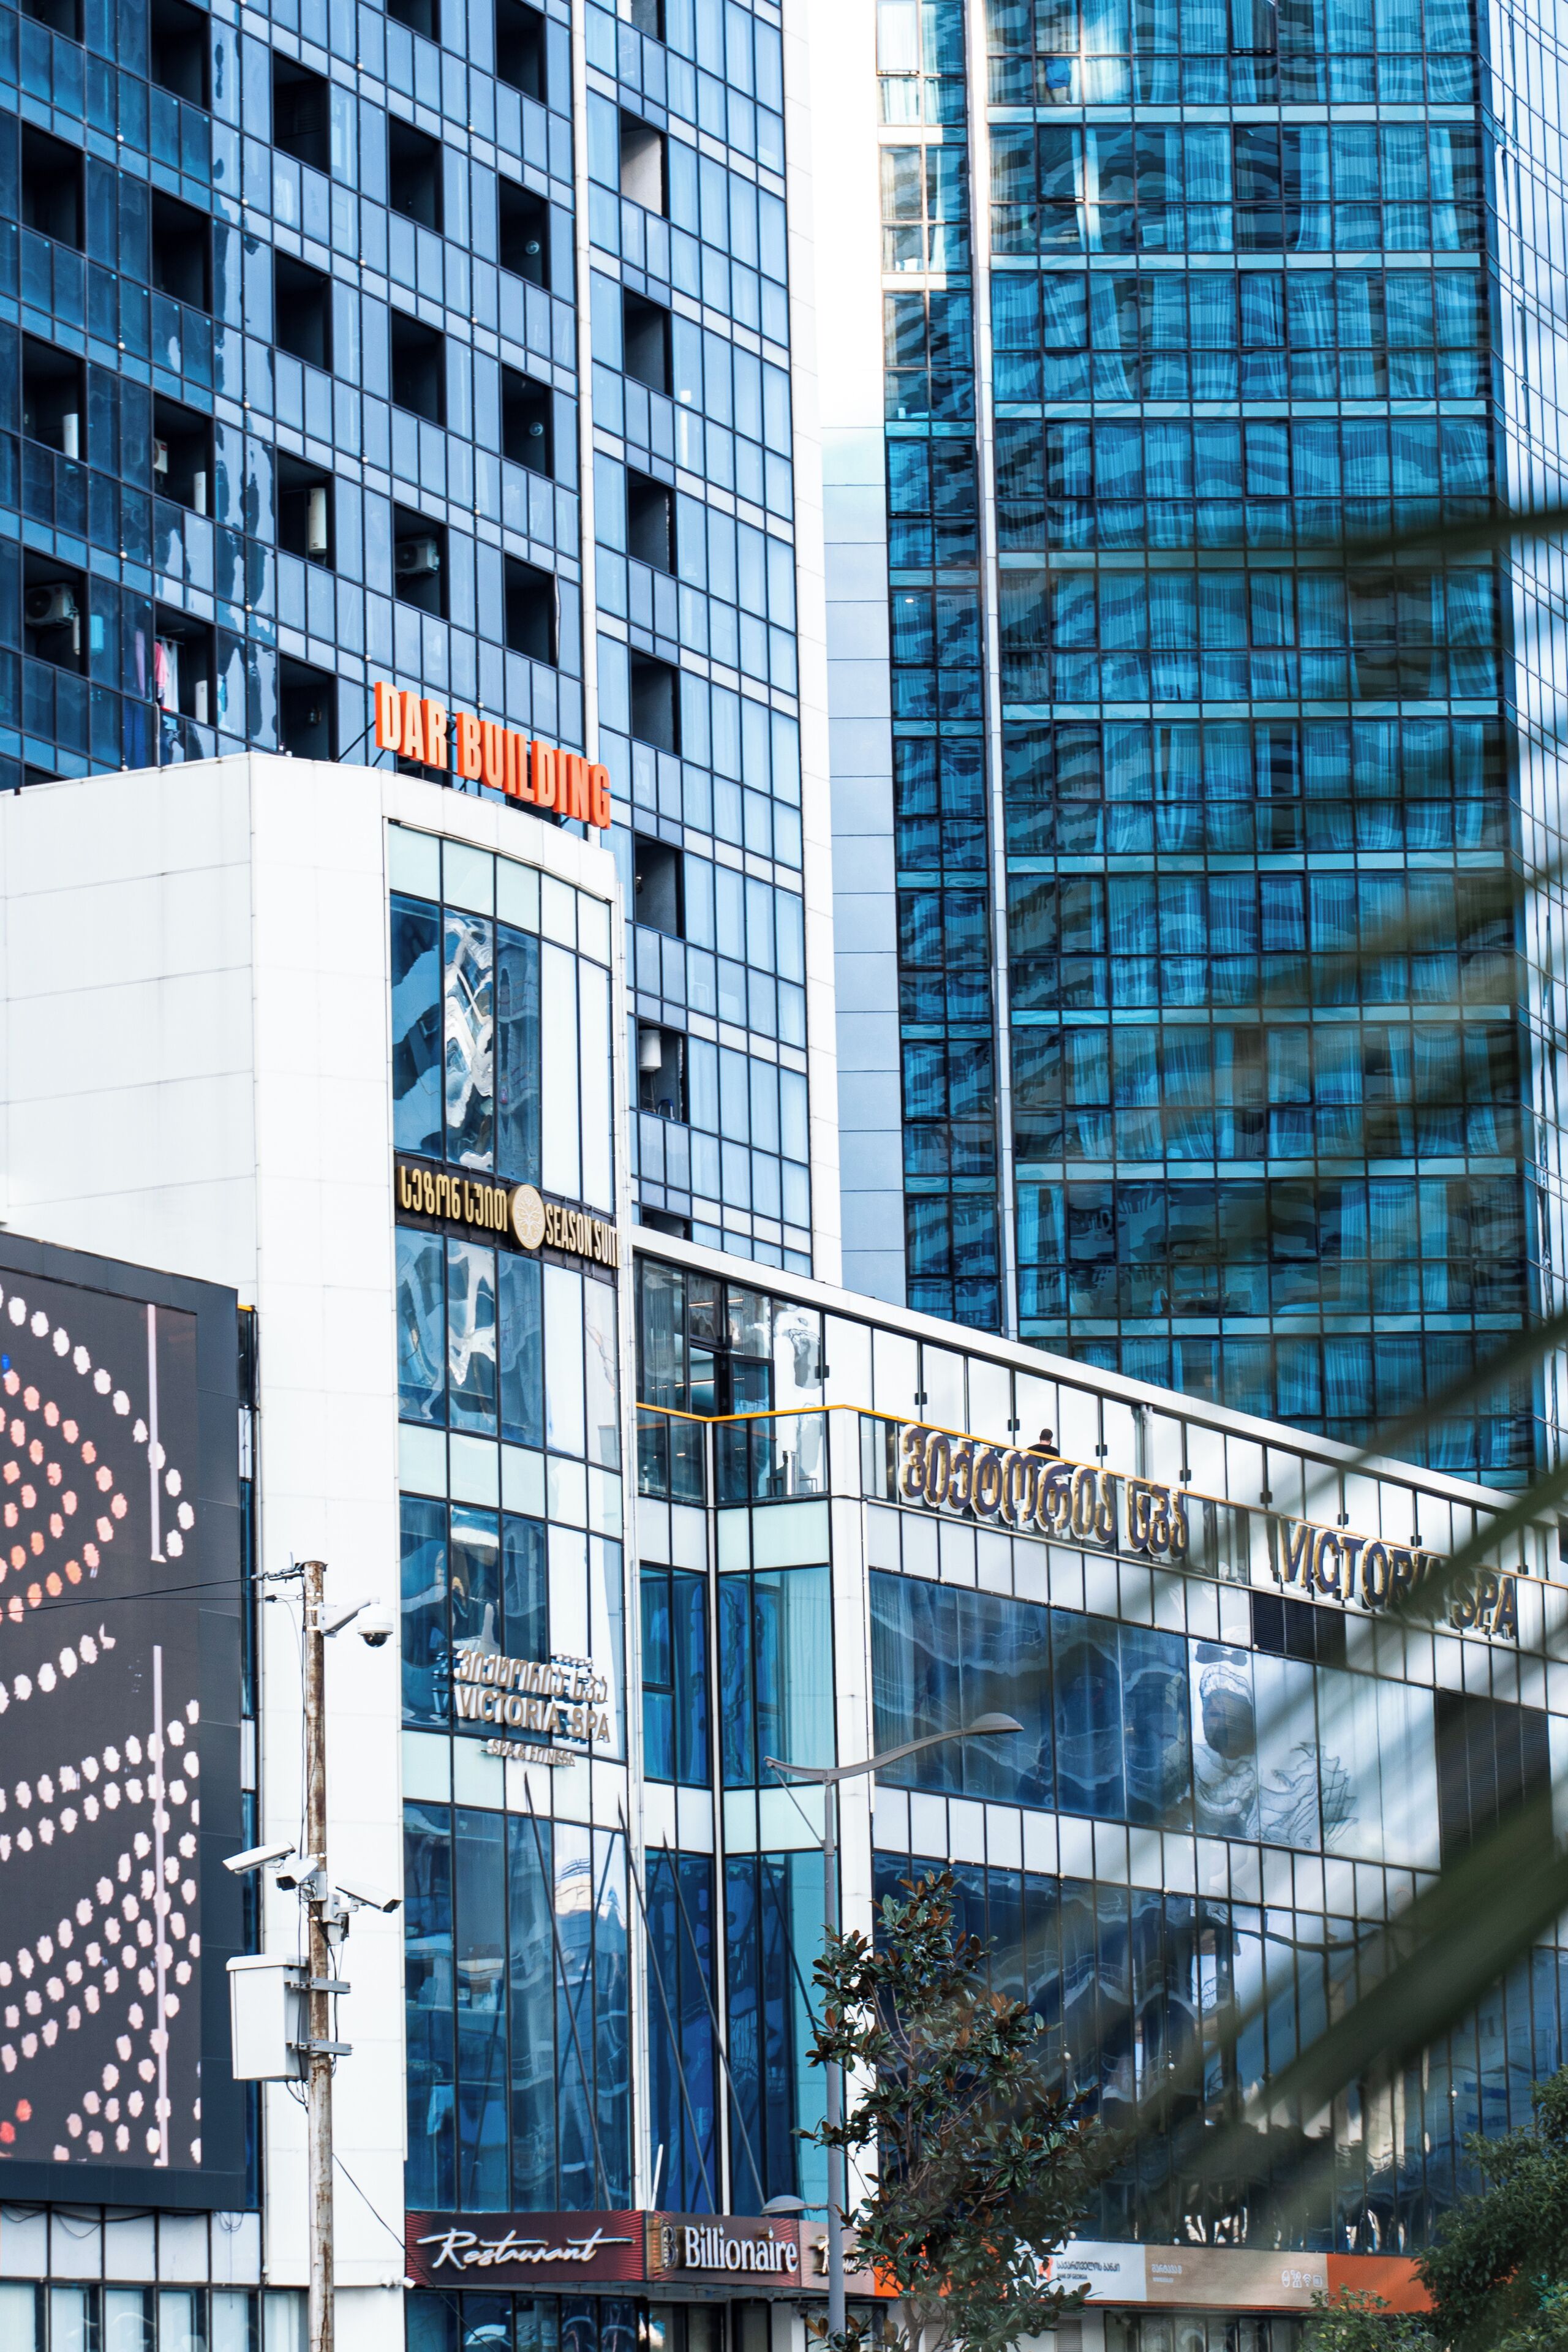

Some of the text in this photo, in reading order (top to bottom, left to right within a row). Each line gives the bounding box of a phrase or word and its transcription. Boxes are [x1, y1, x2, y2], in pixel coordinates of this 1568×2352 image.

[375, 682, 611, 829] DAR BUILDING
[398, 1166, 508, 1232] სეზონ სუით
[545, 1203, 592, 1257] SEASON
[899, 1423, 1189, 1558] ვიქტორია სპა
[1280, 1518, 1519, 1641] VICTOR SPA
[453, 1649, 608, 1704] ვიქტორია სპა
[454, 1684, 611, 1743] VICTORIA SPA
[486, 1738, 512, 1757] SPA
[416, 2227, 636, 2271] Restaurant
[684, 2223, 799, 2274] Billionaire
